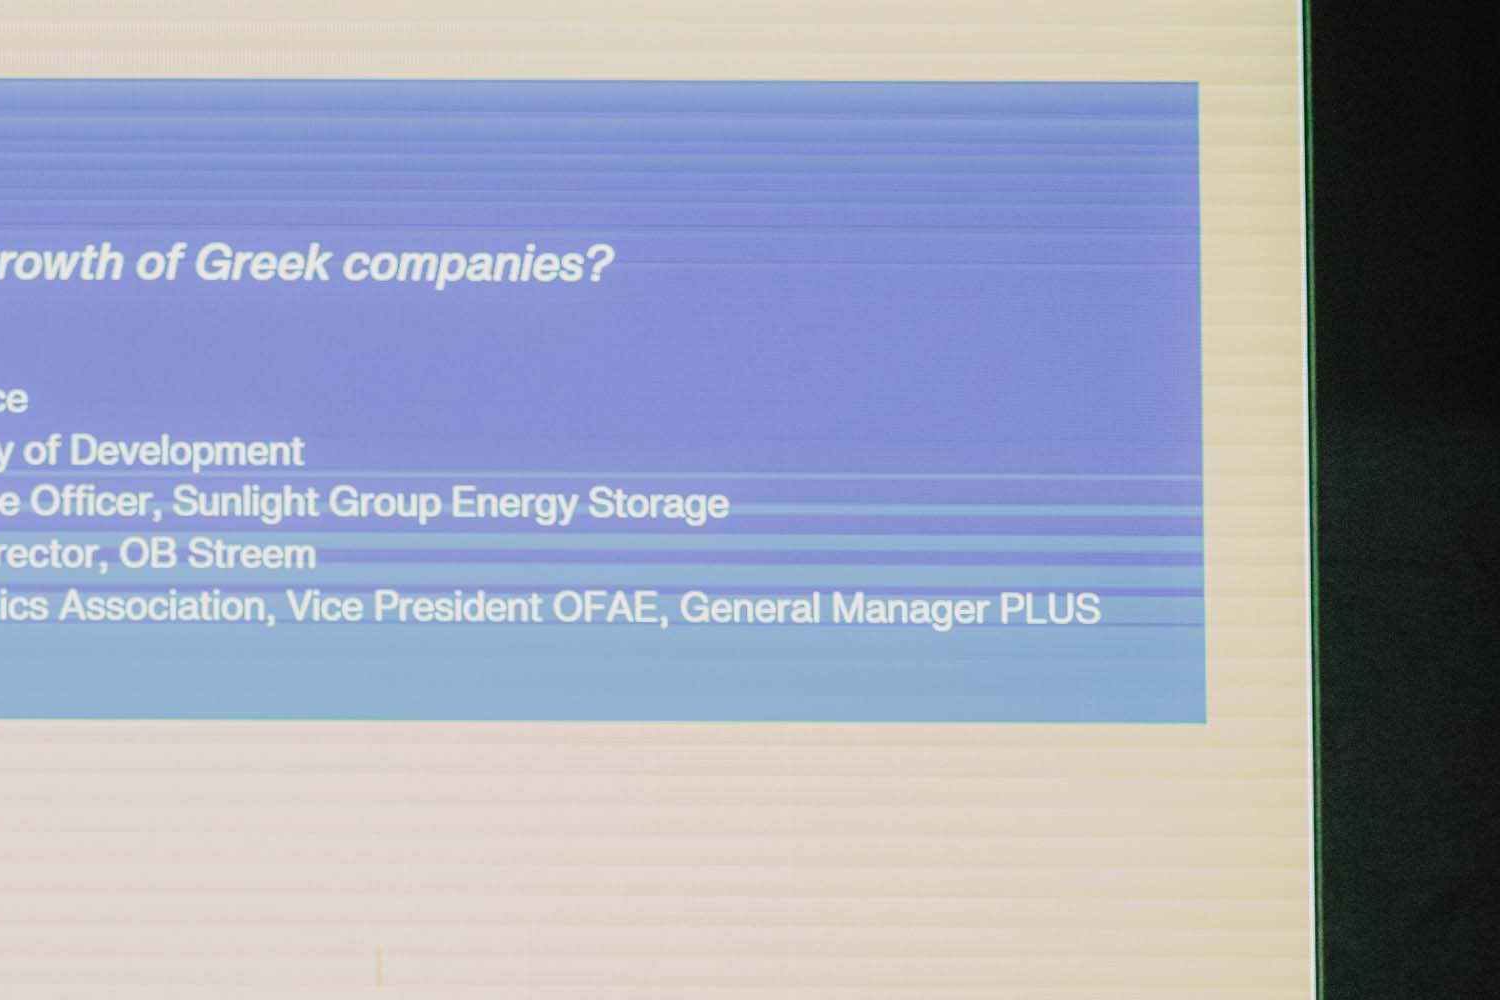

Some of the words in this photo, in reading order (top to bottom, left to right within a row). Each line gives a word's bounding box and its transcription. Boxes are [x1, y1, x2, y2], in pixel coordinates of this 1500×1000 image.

[137, 242, 187, 281] of
[196, 242, 333, 281] Greek
[343, 243, 615, 291] companies?
[24, 433, 61, 465] of
[71, 433, 305, 474] Development
[31, 484, 162, 522] Officer,
[173, 484, 319, 525] Sunlight
[329, 485, 442, 525] Group
[452, 485, 579, 526] Energy
[589, 486, 730, 526] Storage
[120, 536, 177, 569] OB
[188, 536, 316, 569] Streem
[58, 589, 275, 626] Association,
[287, 589, 363, 621] Vice
[375, 589, 543, 622] President
[553, 590, 668, 629] OFAE,
[680, 591, 820, 623] General
[833, 591, 991, 632] Manager
[1001, 592, 1101, 625] PLUS
